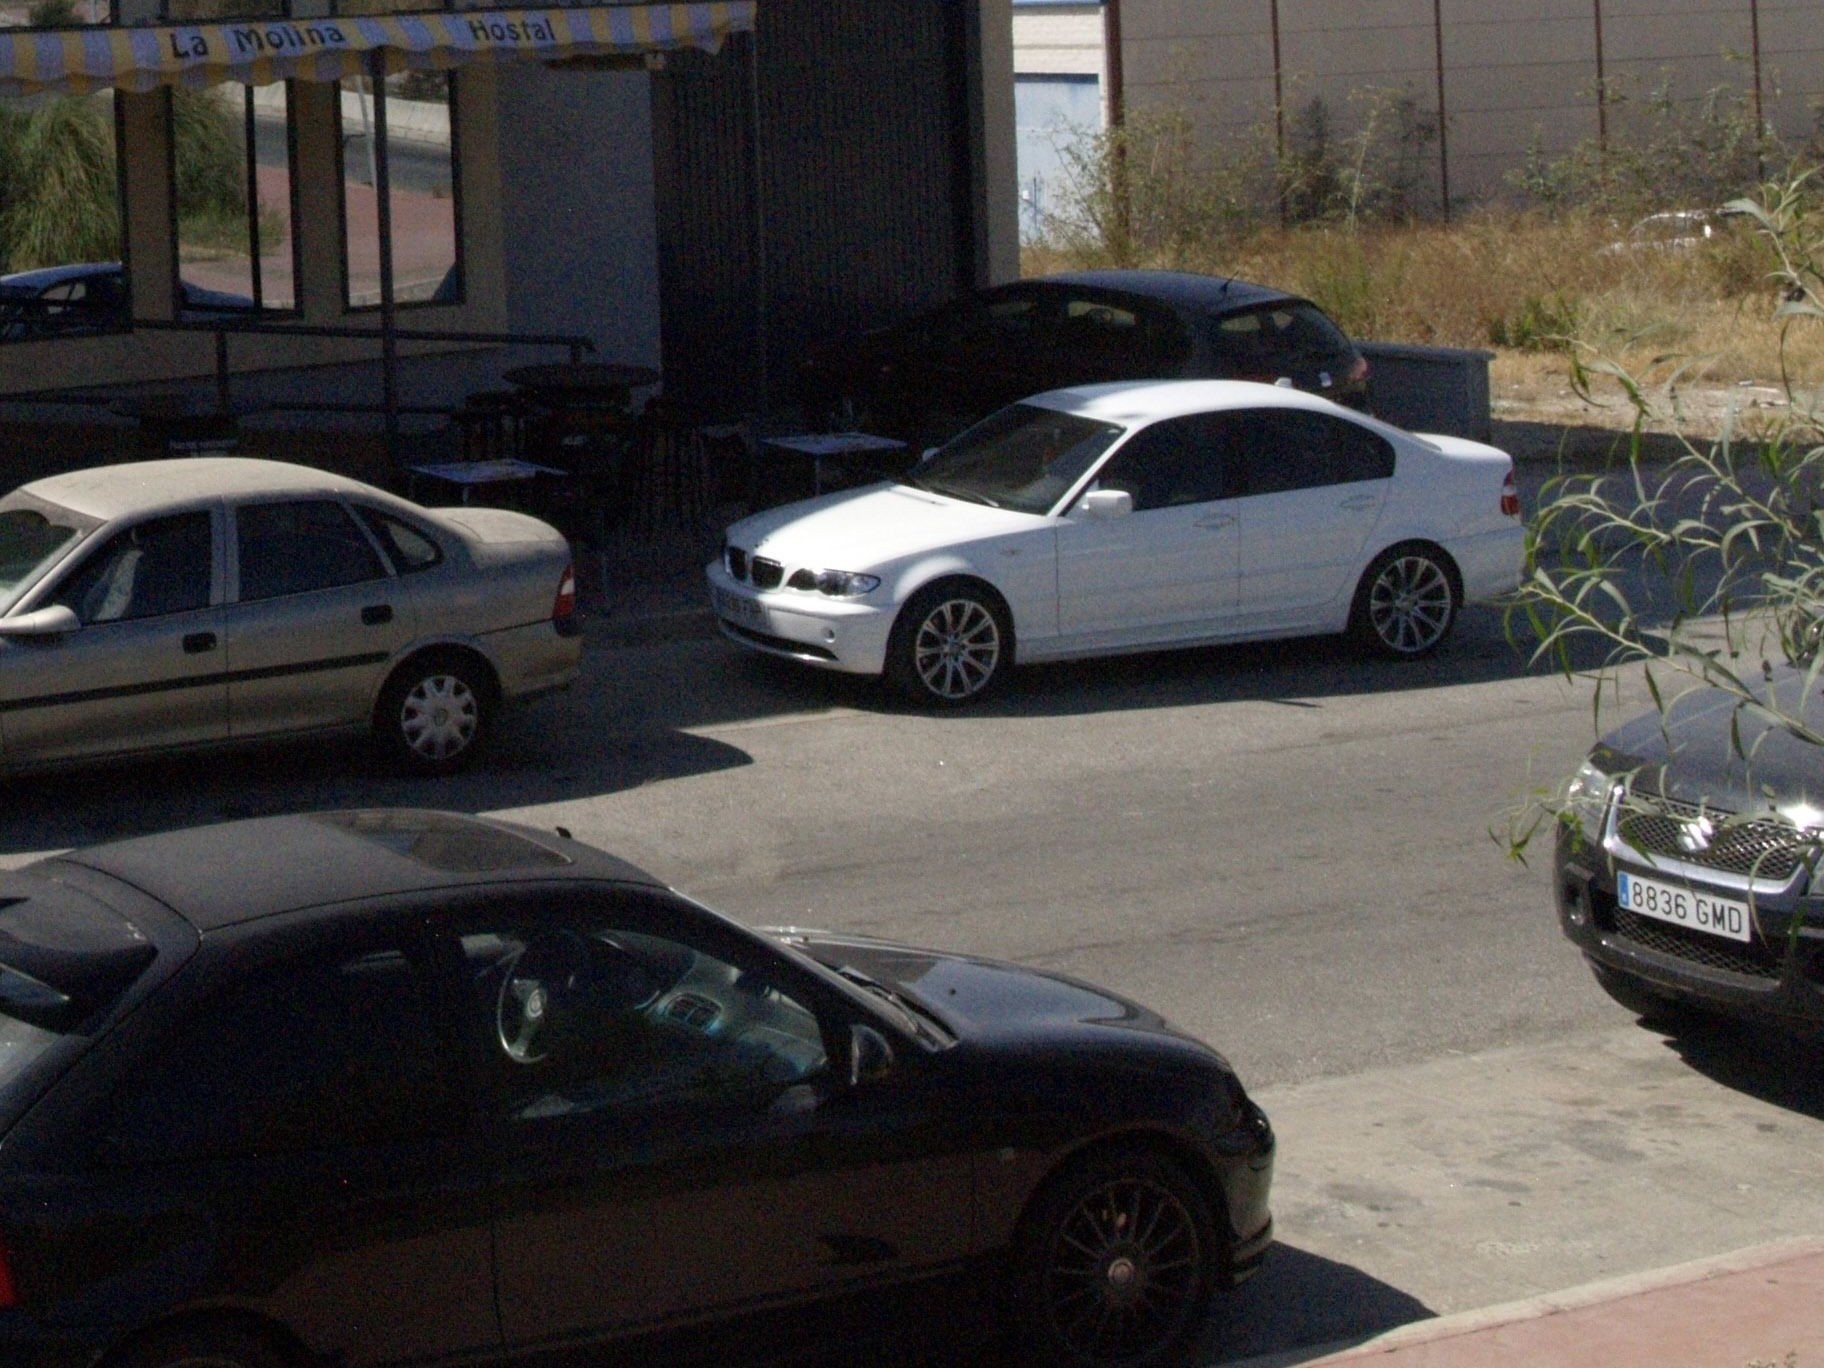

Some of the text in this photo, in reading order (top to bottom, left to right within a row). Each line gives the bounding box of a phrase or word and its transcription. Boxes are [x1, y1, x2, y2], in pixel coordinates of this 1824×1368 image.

[170, 17, 556, 59] La Molina Hostal
[1632, 881, 1743, 934] 8836 GMD
